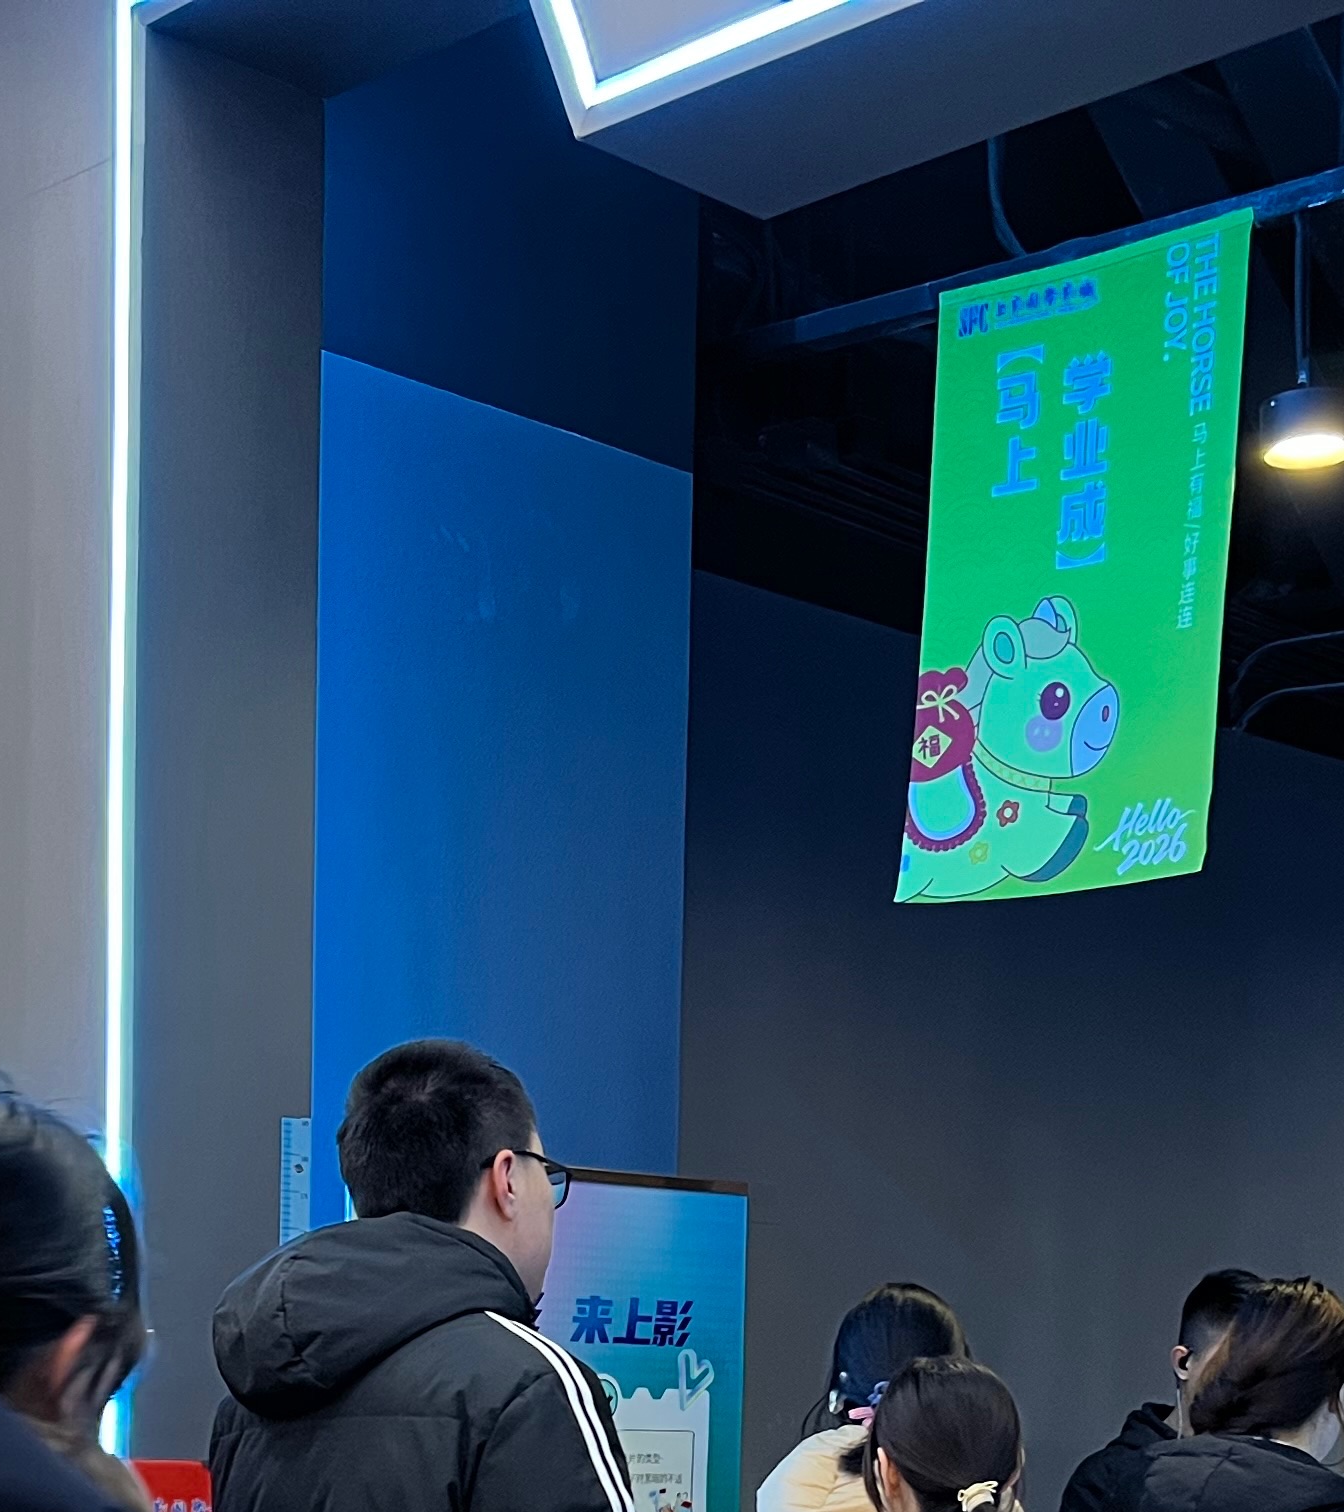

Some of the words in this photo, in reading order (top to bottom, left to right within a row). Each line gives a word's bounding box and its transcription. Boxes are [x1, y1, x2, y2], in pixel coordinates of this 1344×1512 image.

[1165, 241, 1192, 285] OF
[1193, 231, 1221, 296] THE
[1163, 293, 1189, 363] JOY.
[1189, 300, 1216, 417] HORSE
[917, 733, 942, 760] 福
[1094, 798, 1195, 852] Hello
[1116, 834, 1188, 875] 2026
[569, 1295, 694, 1348] 来上影
